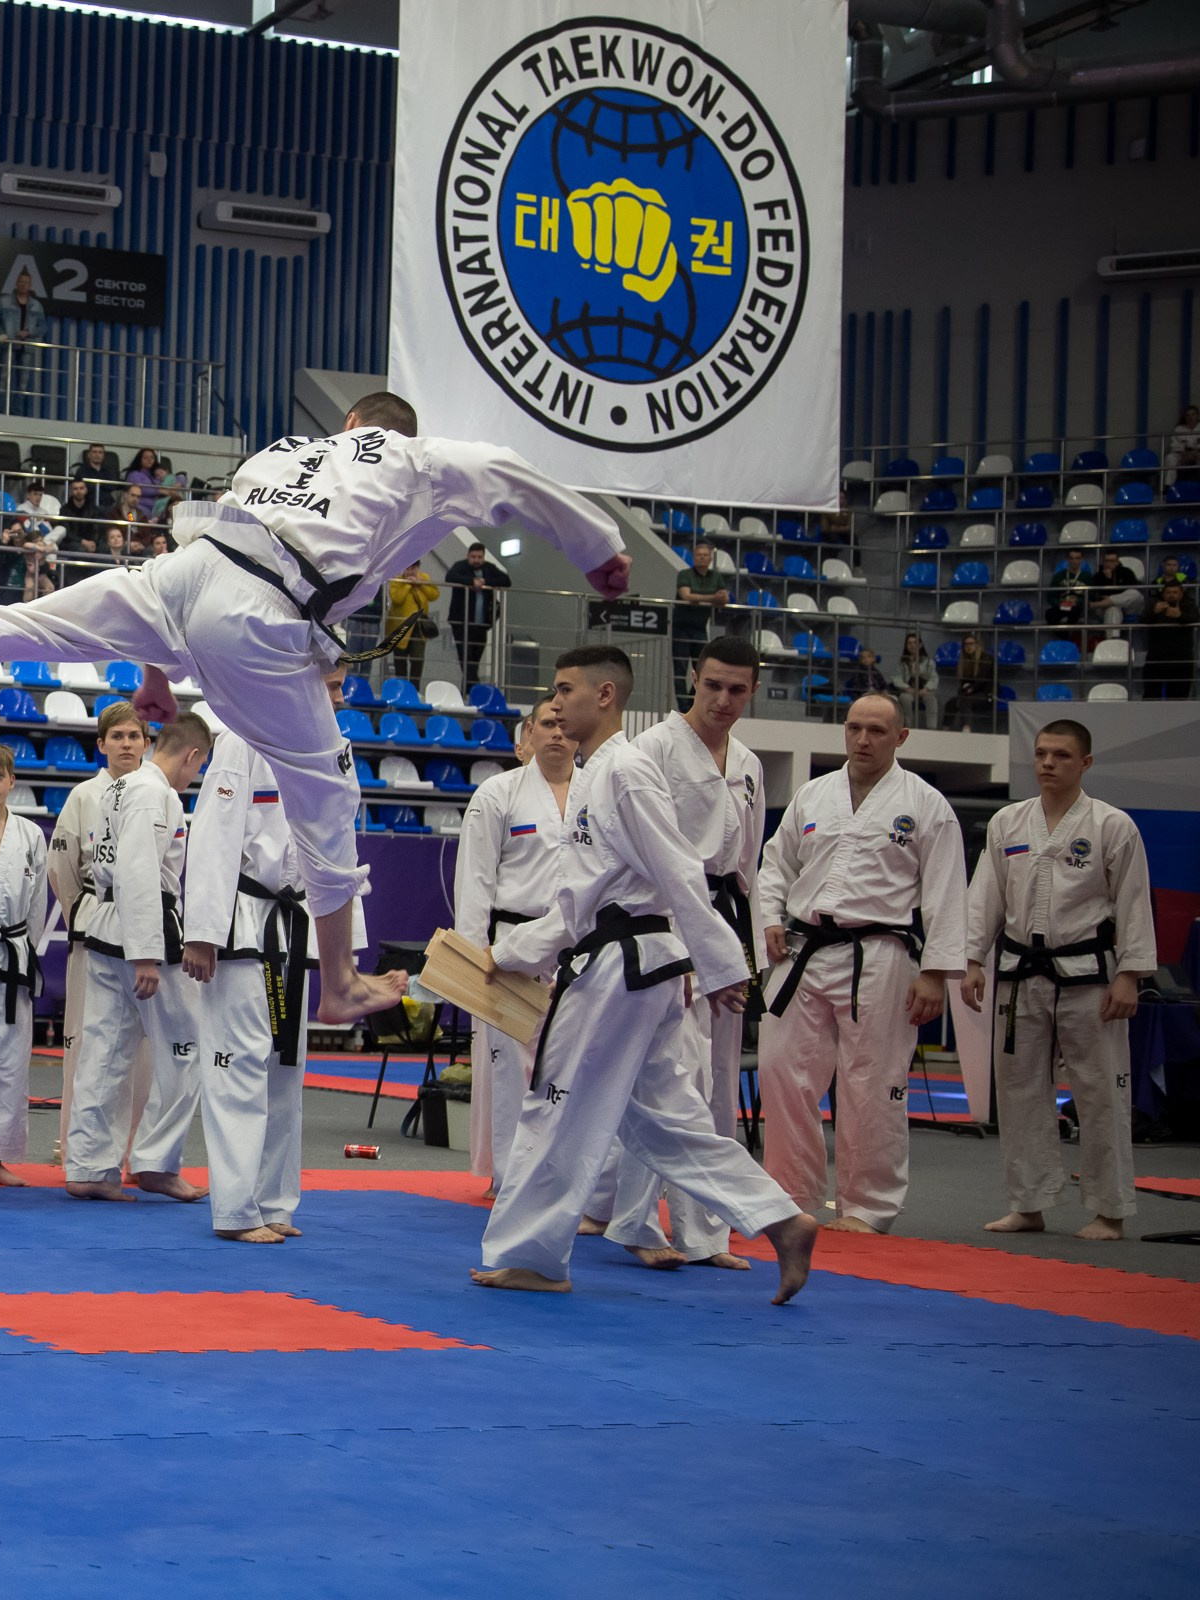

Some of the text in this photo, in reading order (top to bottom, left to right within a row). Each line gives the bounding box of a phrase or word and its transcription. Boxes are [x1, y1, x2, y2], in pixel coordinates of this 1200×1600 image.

[453, 34, 795, 434] INTERNATIONAL TAEKWON-DO FEDERATION
[515, 192, 560, 253] 태
[1, 254, 89, 303] A2
[95, 278, 147, 292] СЕКТОР
[94, 294, 146, 309] SECTOR
[244, 487, 331, 519] RUSSIA
[264, 961, 273, 993] YAROSLAV
